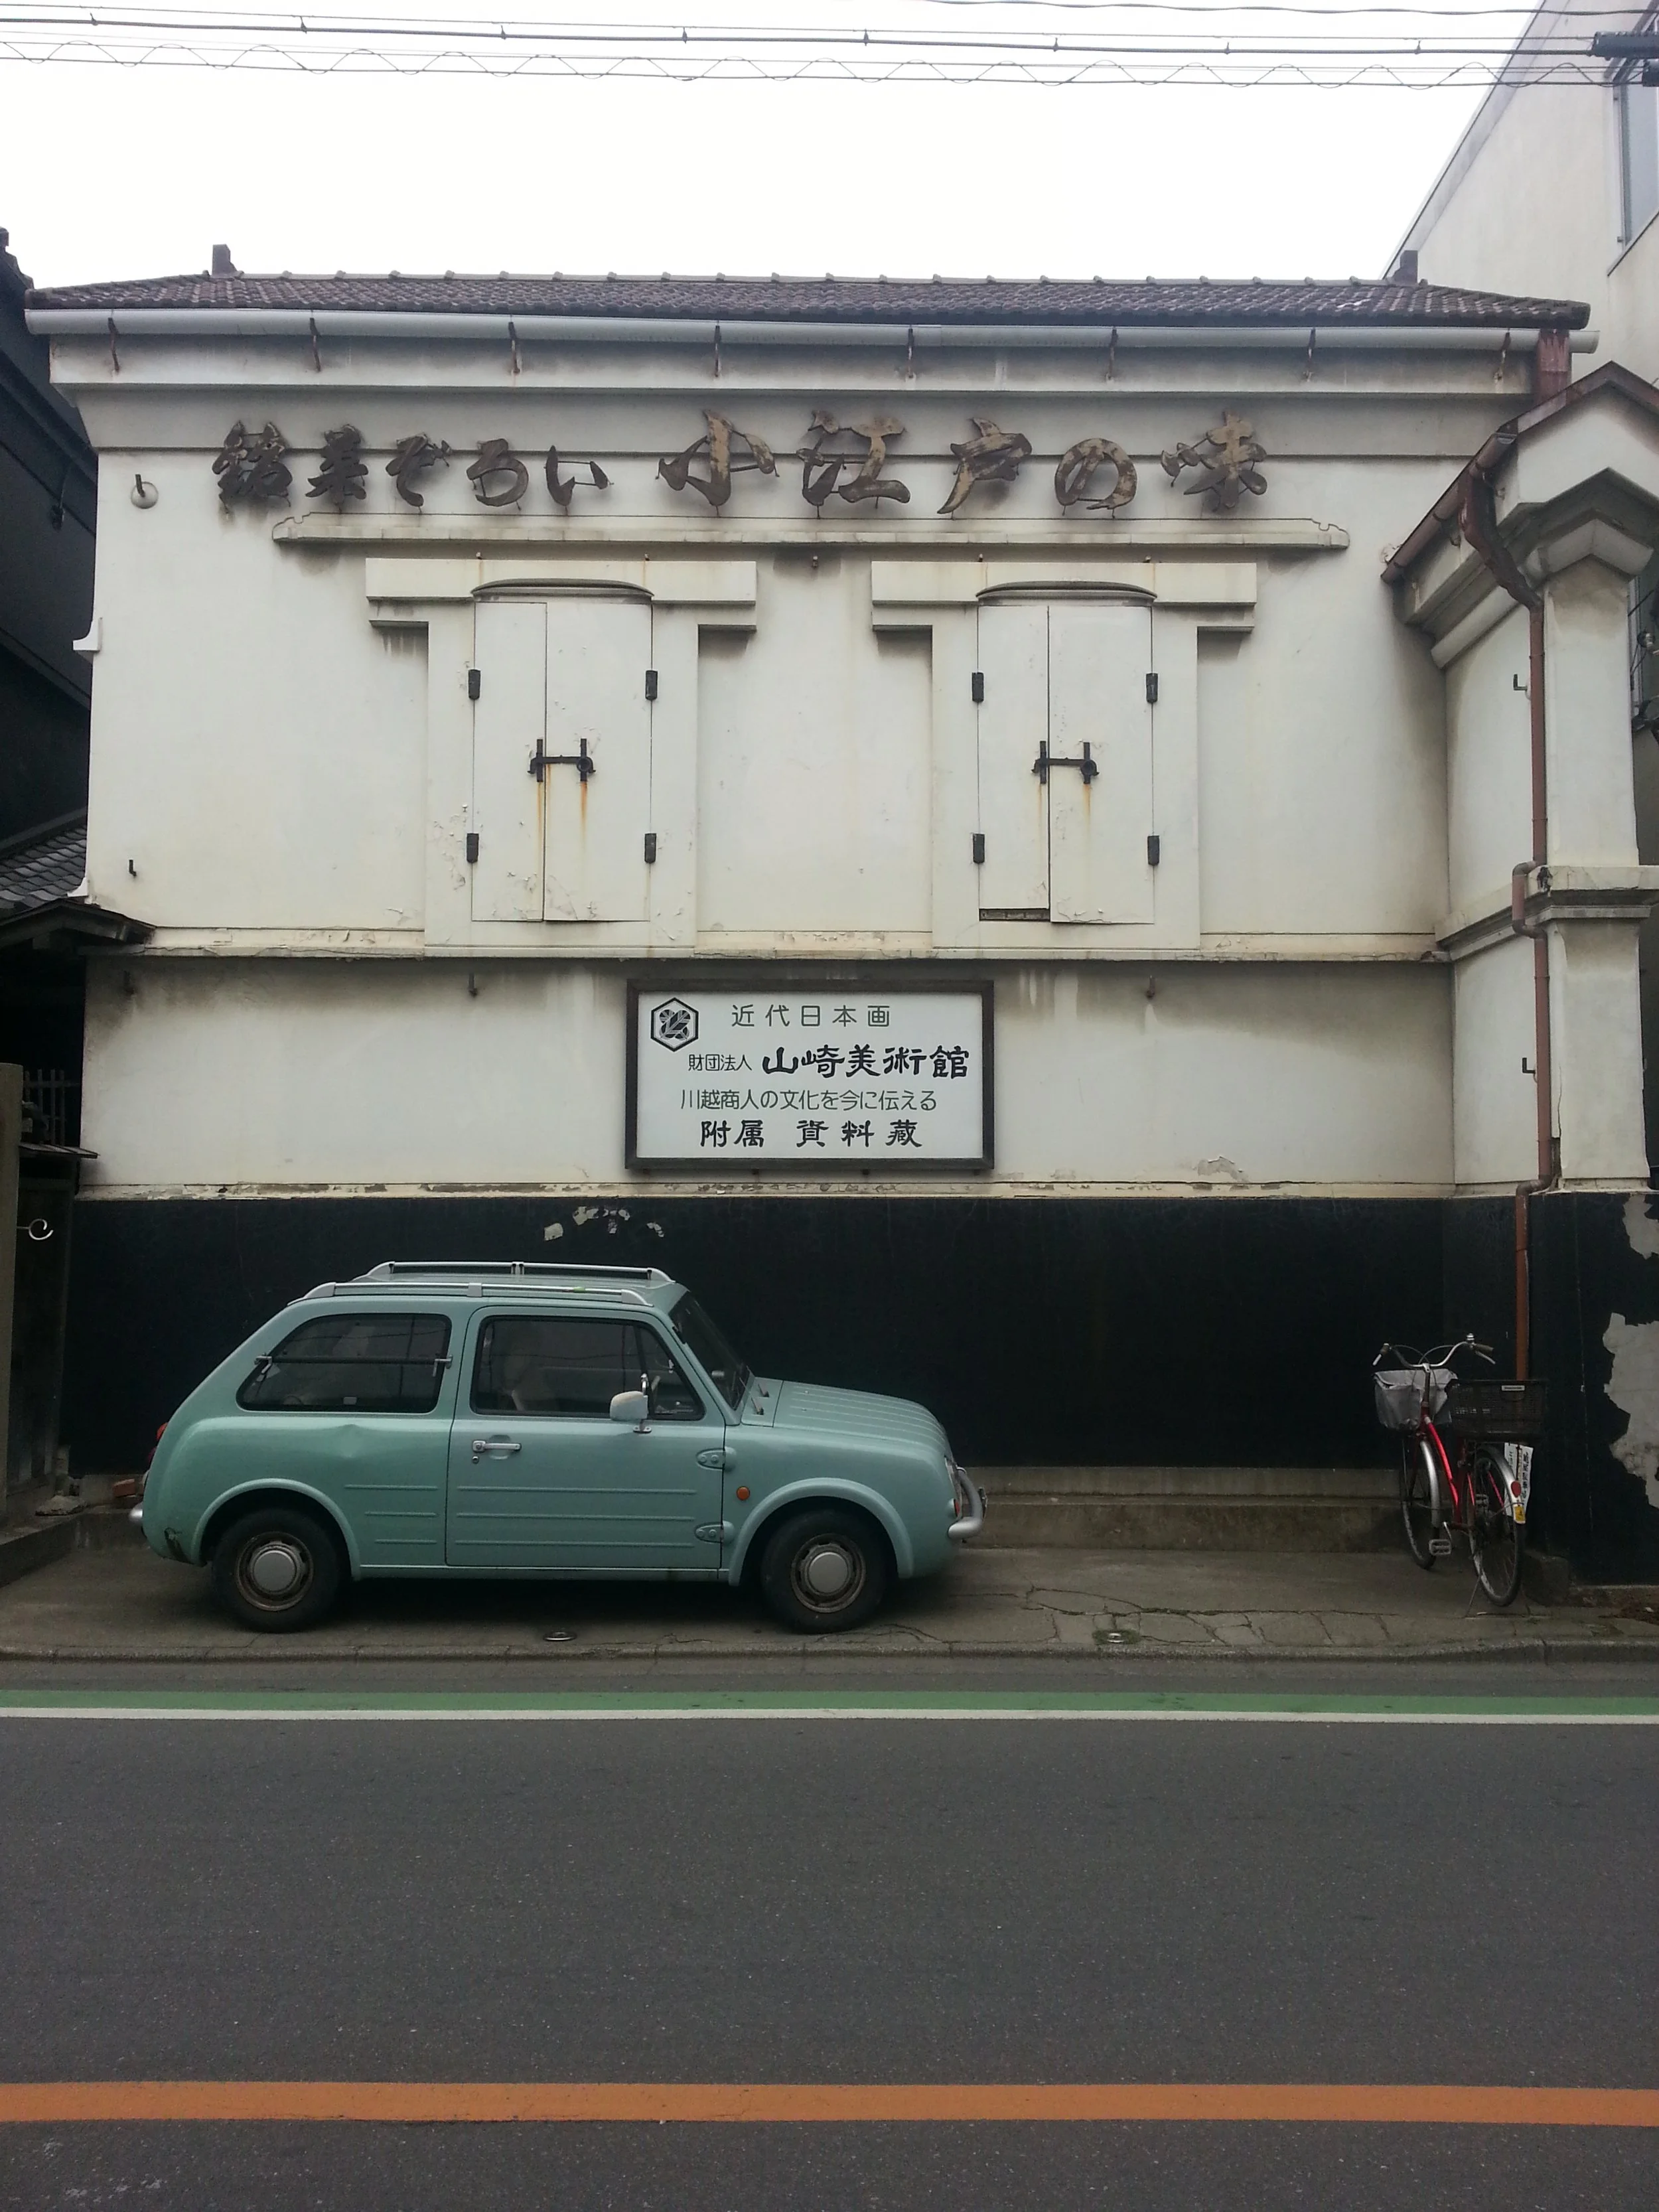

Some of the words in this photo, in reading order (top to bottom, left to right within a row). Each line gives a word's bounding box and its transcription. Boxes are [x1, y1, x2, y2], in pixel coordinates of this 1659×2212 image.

[731, 1004, 890, 1027] 近代日本画
[687, 1053, 753, 1072] 財団法人
[762, 1044, 970, 1080] 山崎美術館
[681, 1089, 937, 1111] 川越商人の文化を今に伝える
[700, 1120, 764, 1147] 附属
[796, 1119, 922, 1148] 資料蔵
